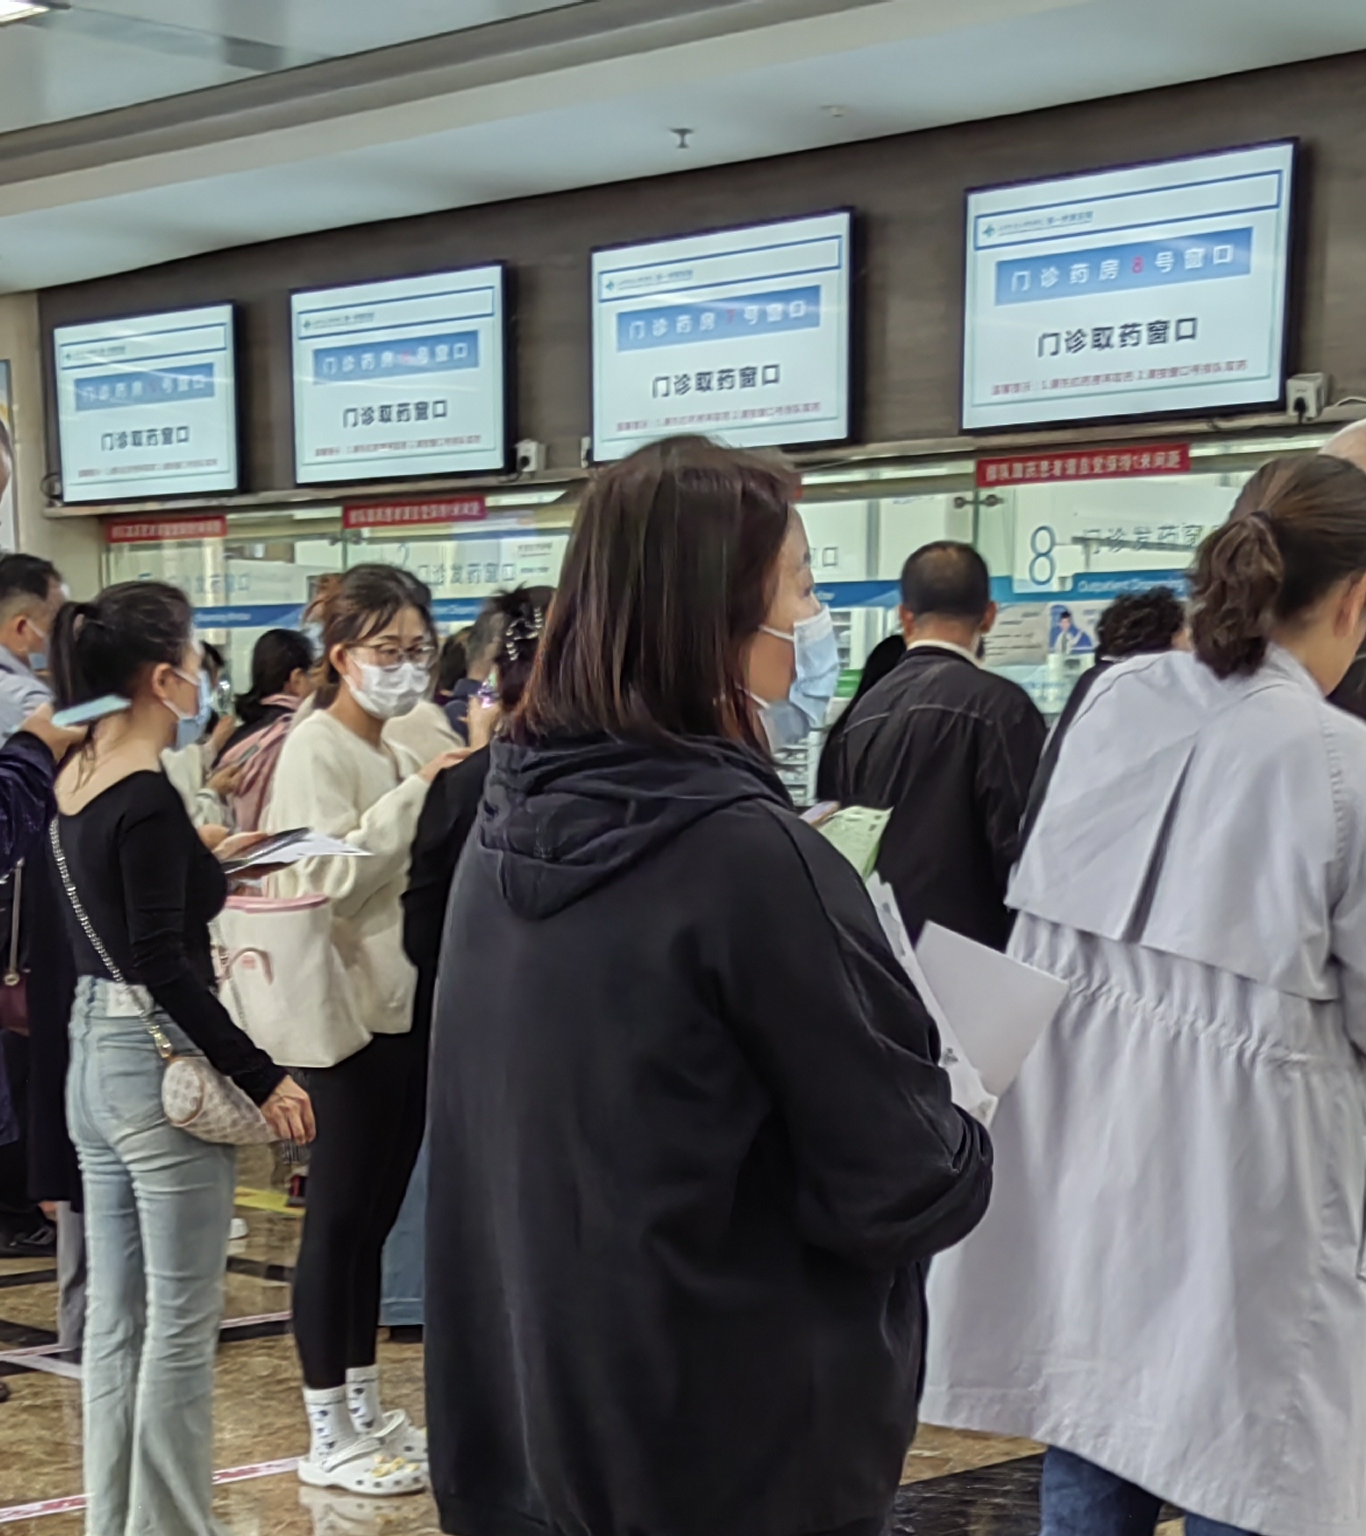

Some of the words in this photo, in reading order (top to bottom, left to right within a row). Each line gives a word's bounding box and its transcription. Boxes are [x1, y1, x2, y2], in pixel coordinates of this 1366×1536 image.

[1011, 244, 1233, 292] 门诊药房8号窗口
[1037, 317, 1197, 357] 门诊取药窗口
[652, 364, 780, 398] 门诊取药窗口
[343, 400, 447, 428] 门诊取药窗口
[1029, 525, 1056, 586] 8
